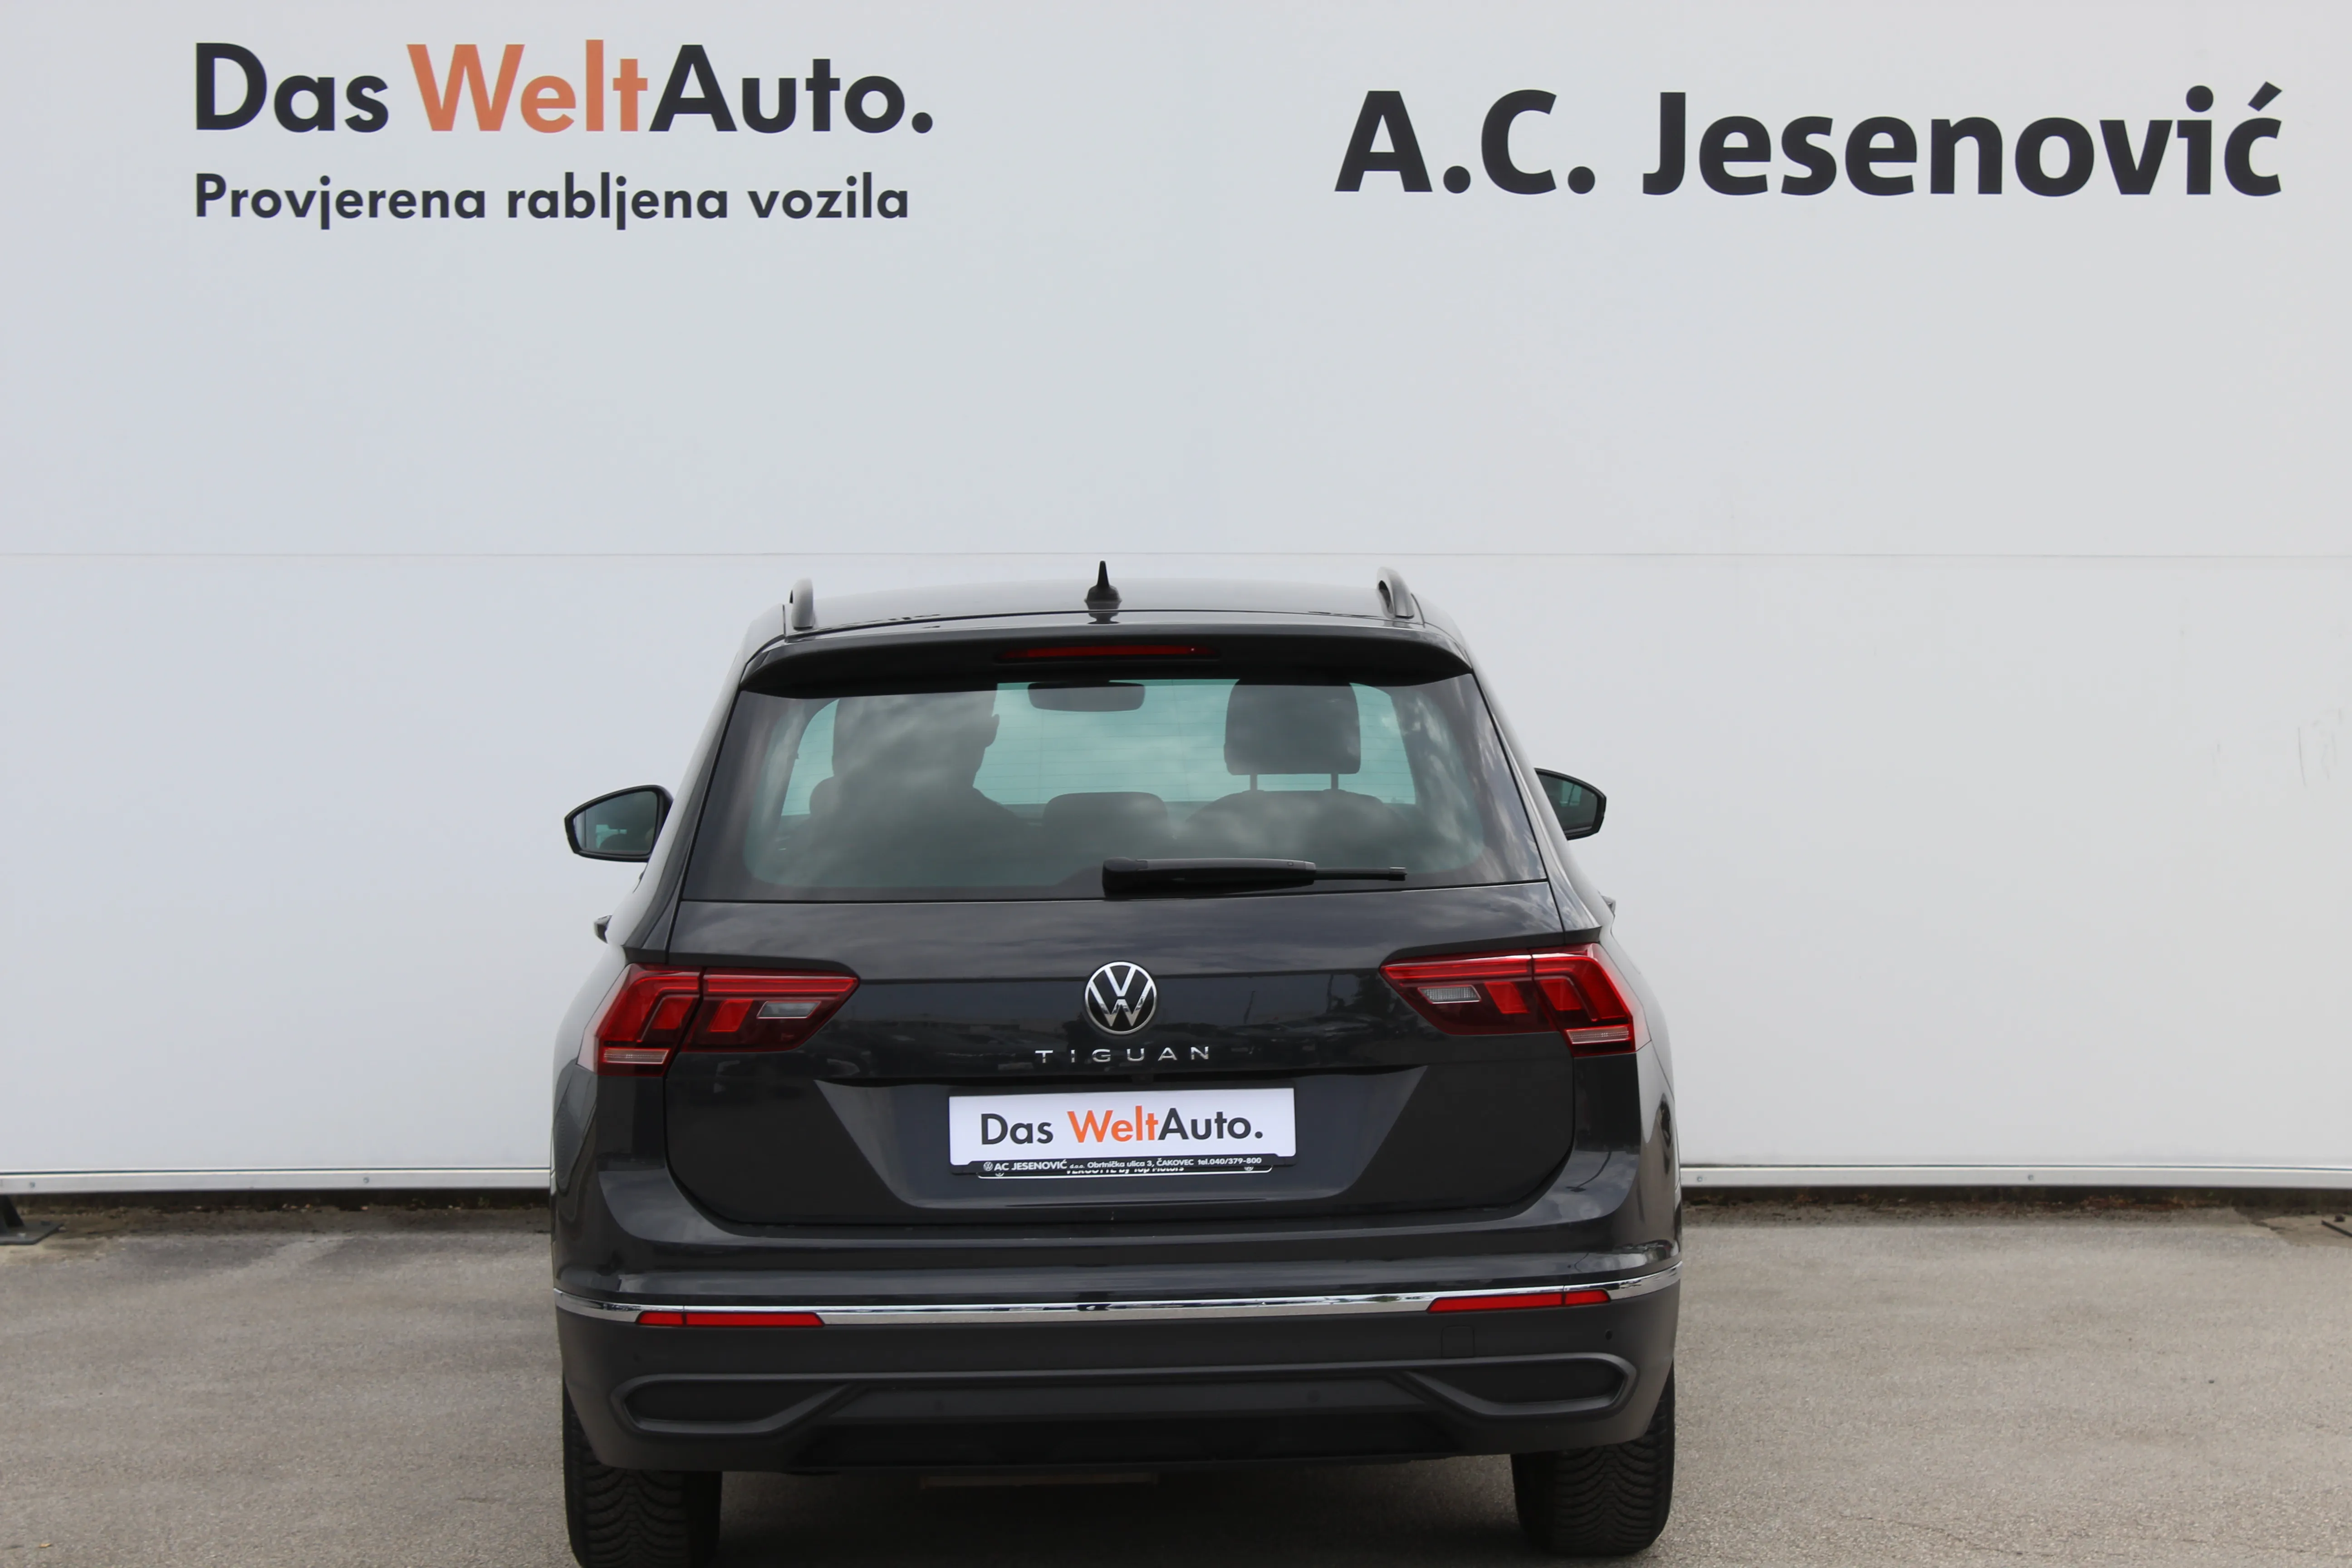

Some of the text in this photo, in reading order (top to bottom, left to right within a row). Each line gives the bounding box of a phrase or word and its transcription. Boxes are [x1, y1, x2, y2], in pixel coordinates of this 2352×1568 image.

[196, 40, 933, 133] Das WeltAuto.
[1335, 82, 2282, 197] A.C. Jesenović
[196, 172, 907, 230] Provjerena rabljena vozila
[1035, 1046, 1210, 1063] TIGUAN
[981, 1106, 1263, 1145] Das WeltAuto.
[994, 1163, 1009, 1171] AC
[1011, 1159, 1068, 1171] JESENOVIĆ
[1156, 1158, 1194, 1166] ČAKOVEC
